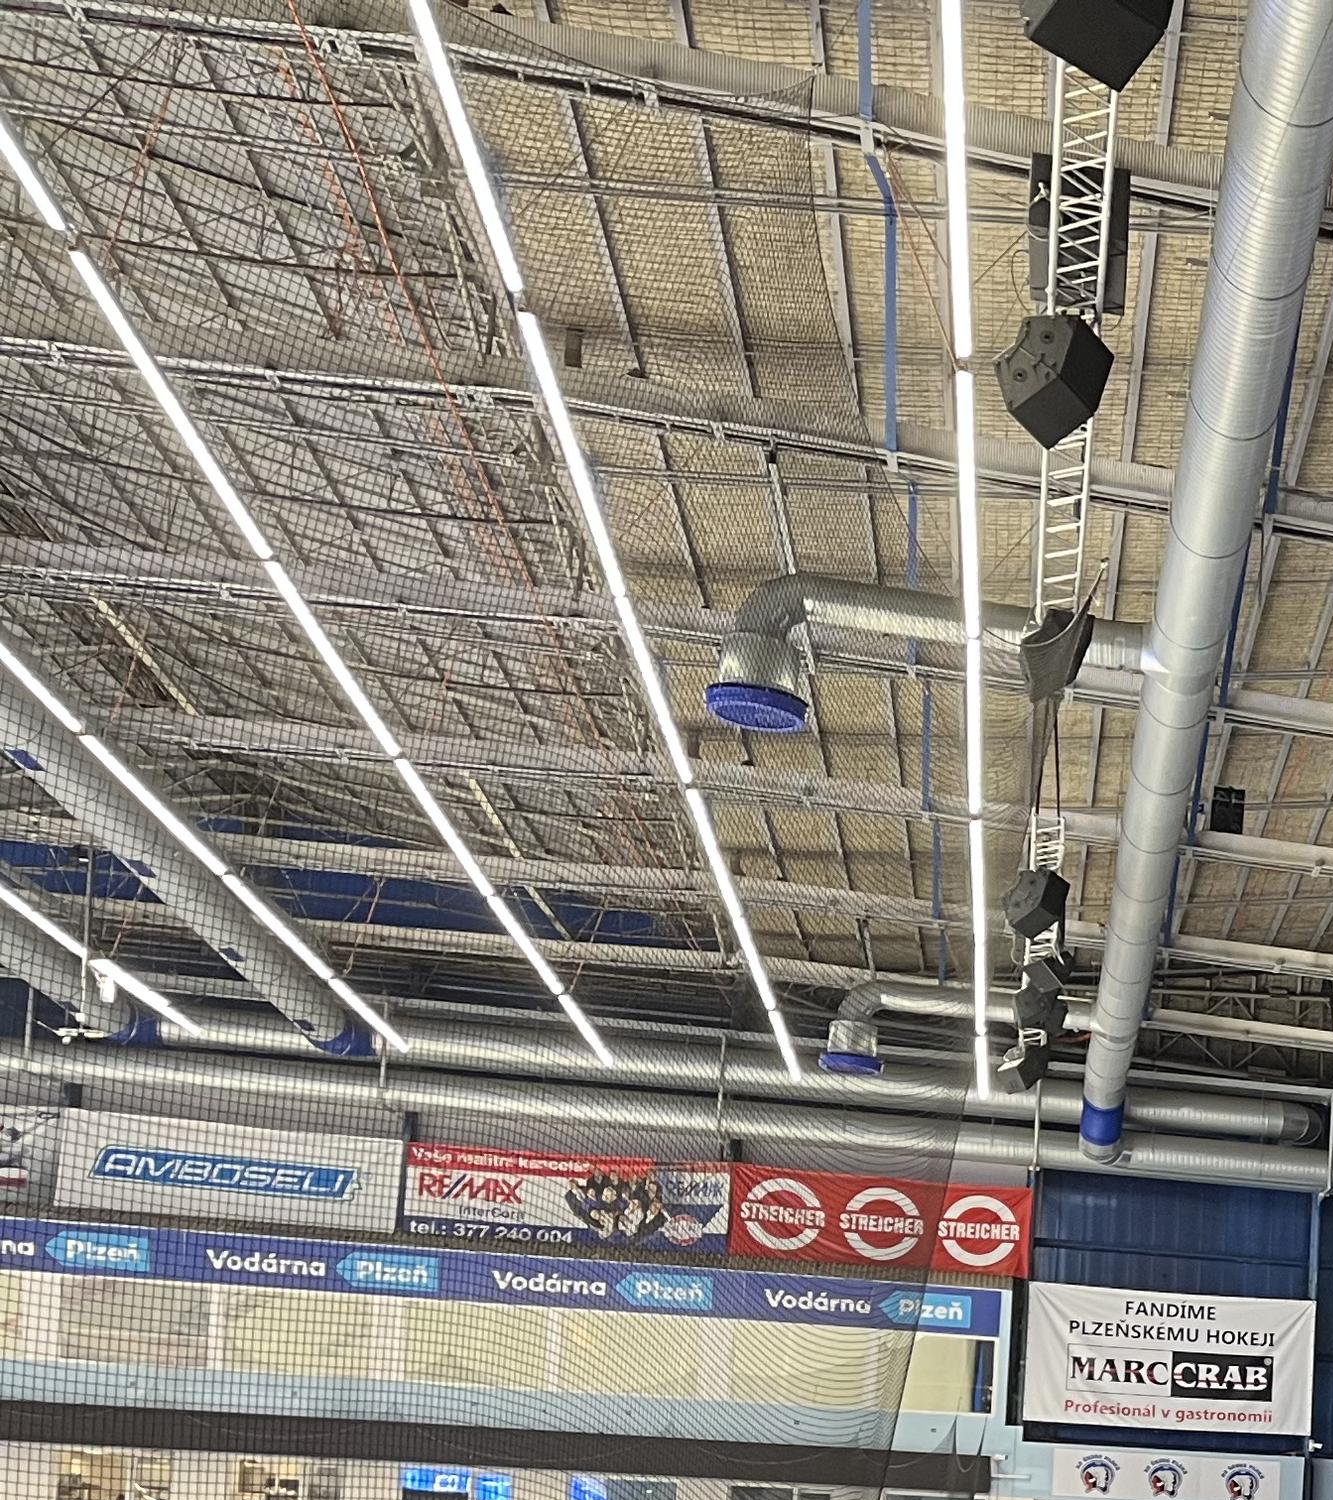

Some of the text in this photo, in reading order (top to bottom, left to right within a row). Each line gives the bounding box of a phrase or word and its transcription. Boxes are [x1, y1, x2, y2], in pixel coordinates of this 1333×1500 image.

[104, 1153, 345, 1193] AMBOSELI
[740, 1201, 826, 1228] STREICHER
[839, 1212, 925, 1236] STREICHER
[453, 1222, 489, 1238] 377
[937, 1220, 1021, 1242] STREICHER
[66, 1237, 139, 1262] Plzeň
[205, 1248, 429, 1284] Vodárna Plzeň
[491, 1269, 705, 1302] Vodárna Plzeň
[764, 1288, 964, 1321] Vodárna Plzeň
[1124, 1300, 1217, 1321] FANDÍME
[1068, 1318, 1275, 1347] PLZEŇSKÉMU HOKEJI
[1070, 1355, 1269, 1392] MARC CRAB
[1064, 1399, 1273, 1423] Profesionál v gastronomii
